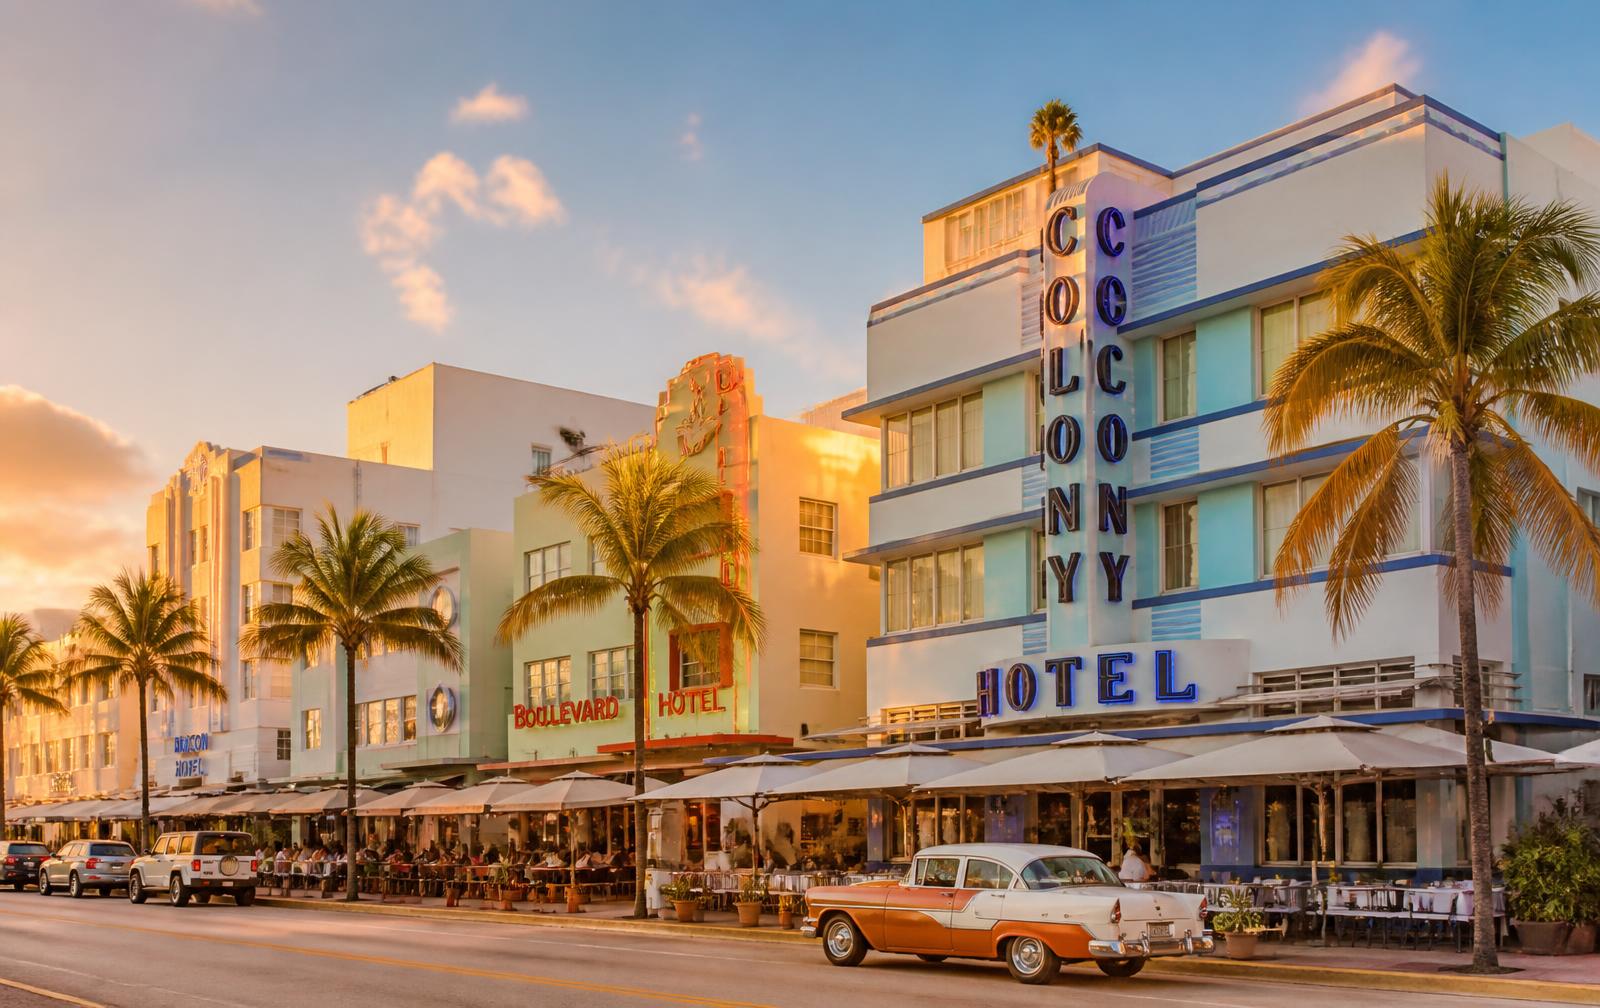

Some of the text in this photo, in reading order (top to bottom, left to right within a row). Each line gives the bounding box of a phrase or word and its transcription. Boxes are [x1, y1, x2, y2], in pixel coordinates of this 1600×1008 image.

[1045, 206, 1081, 603] COLONY
[658, 687, 726, 717] HOTEL
[976, 650, 1196, 717] HOTEL
